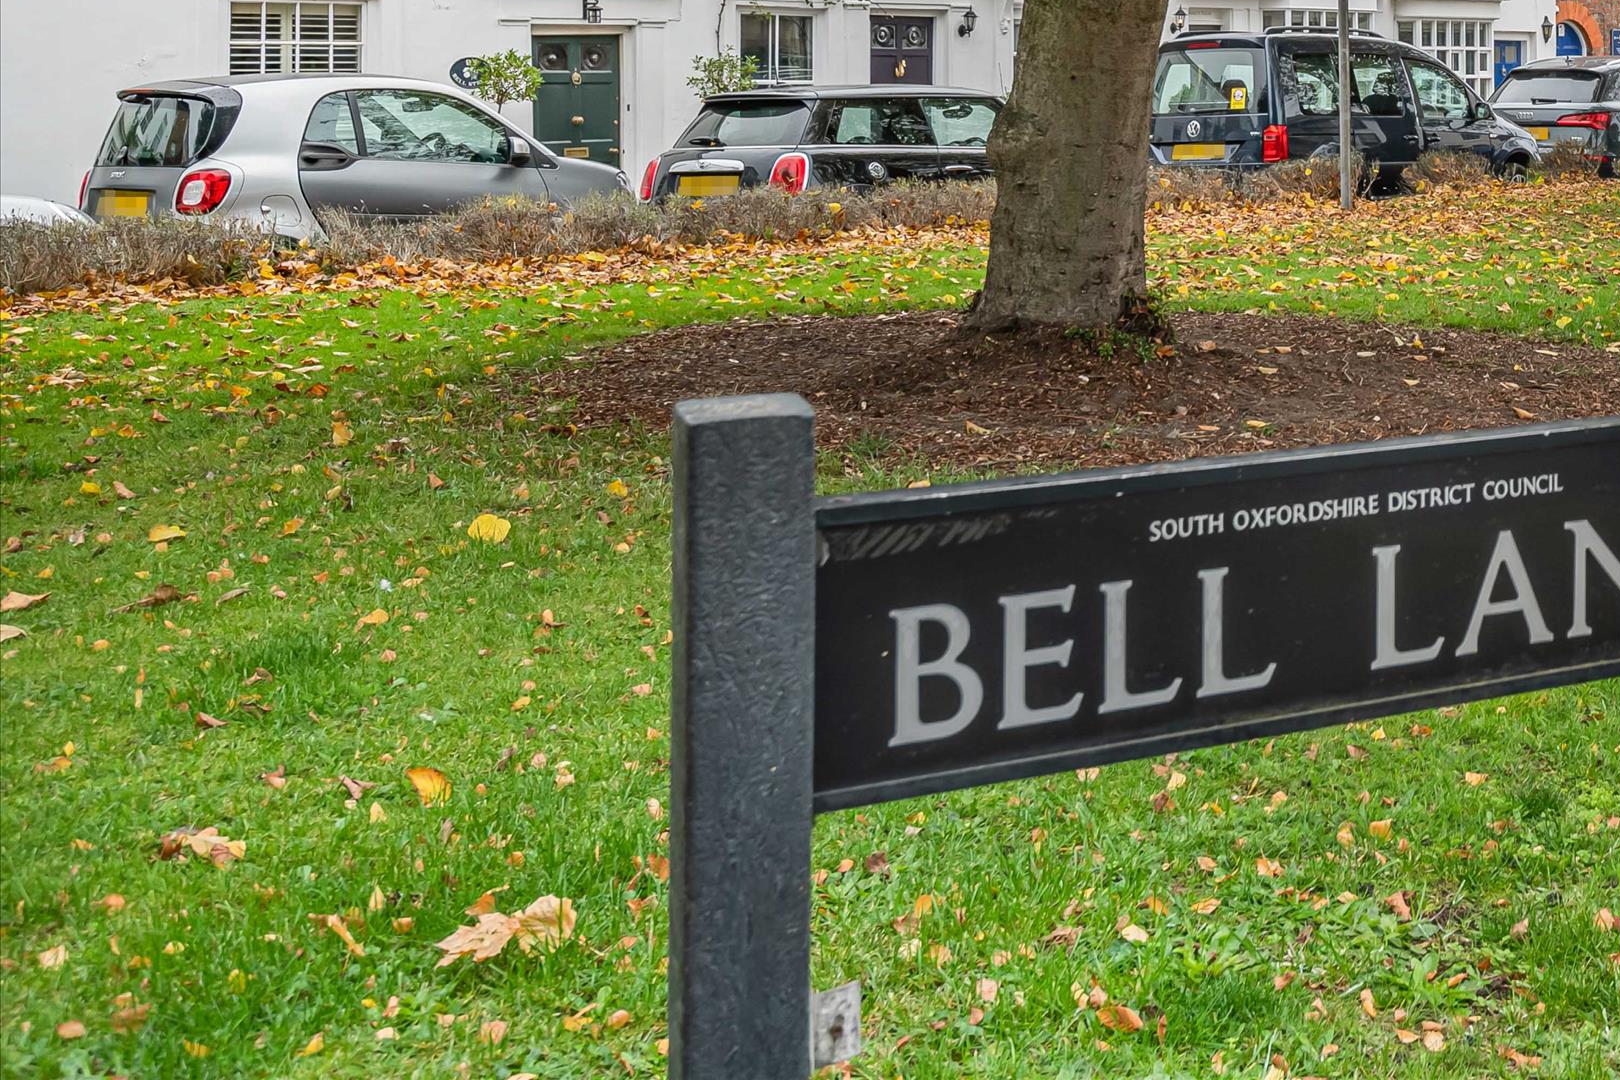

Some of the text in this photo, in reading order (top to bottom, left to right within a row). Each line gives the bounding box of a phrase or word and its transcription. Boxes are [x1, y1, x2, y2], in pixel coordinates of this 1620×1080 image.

[1148, 473, 1564, 543] SOUTH OXFORDSHIRE DISTRICT COUNCIL
[887, 566, 1278, 748] BELL
